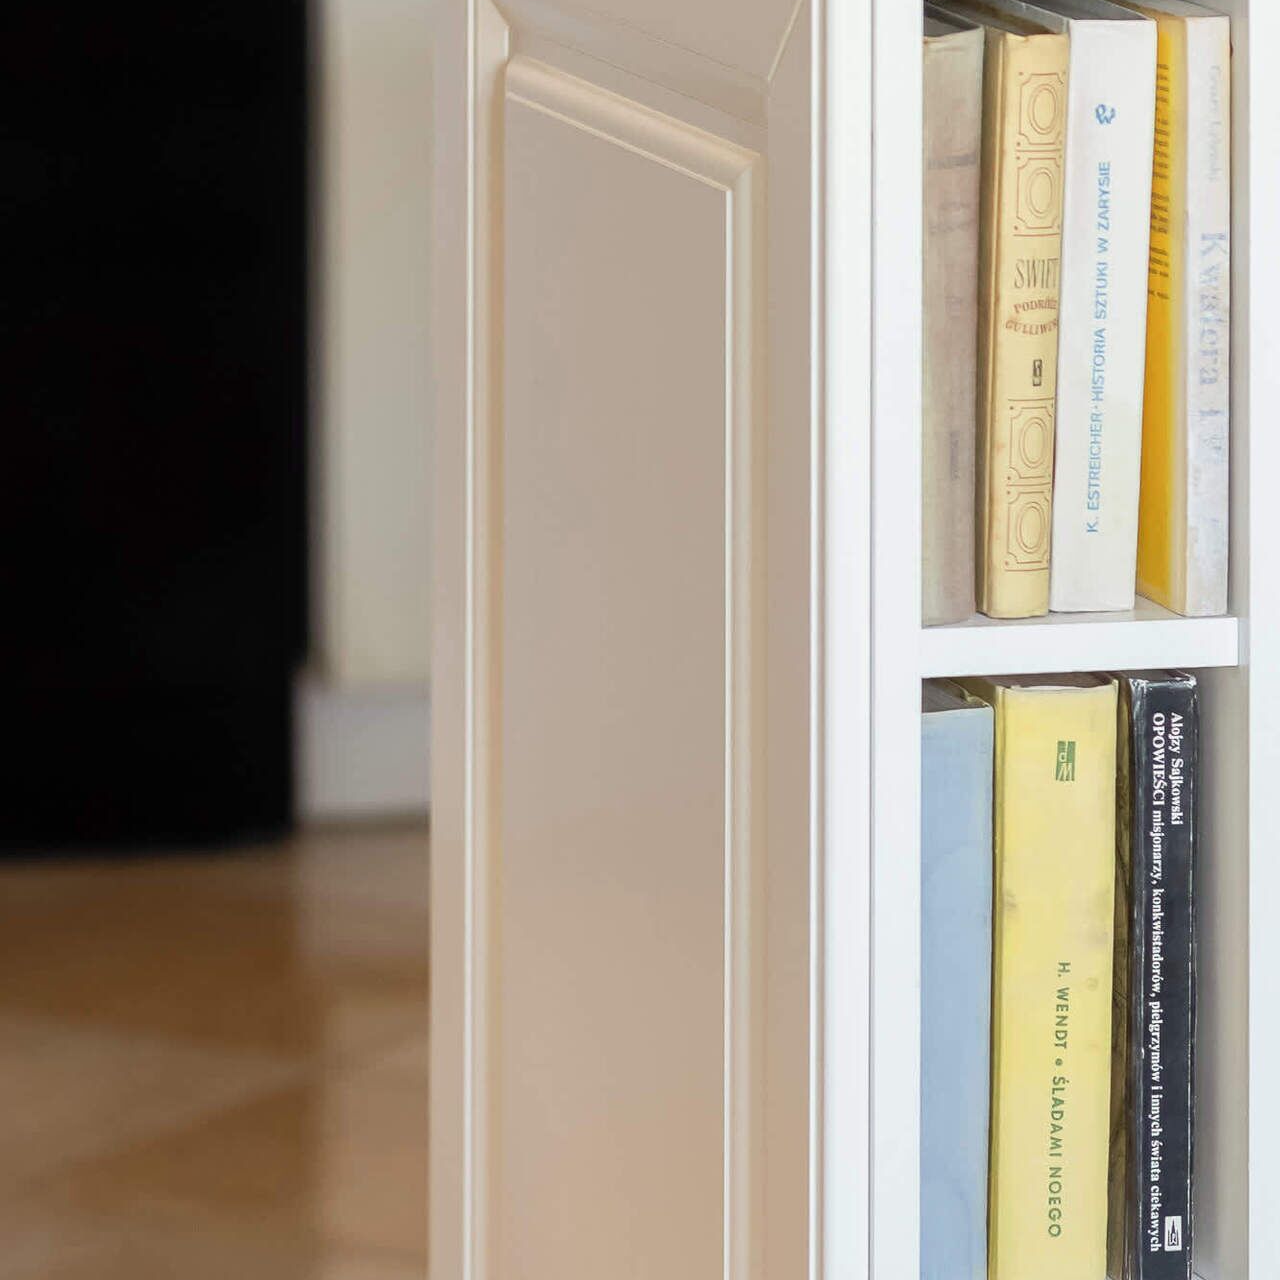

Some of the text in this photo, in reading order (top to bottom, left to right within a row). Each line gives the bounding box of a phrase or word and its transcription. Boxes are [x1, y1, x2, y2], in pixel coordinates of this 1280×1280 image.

[1014, 257, 1058, 289] SWIFT
[1086, 161, 1111, 534] K. ESTREICHER HISTORIA SZTUKI W ZARYSIE
[1151, 712, 1167, 806] OPOWIEŚCI
[1168, 712, 1184, 824] Alojzy Sajkowski
[1150, 810, 1165, 884] misjonarzy,
[1150, 889, 1164, 998] konkwistadorów,
[1150, 1002, 1164, 1082] pielgrzymów
[1047, 961, 1071, 1238] H. WENDT ŚLADAMI NOEGO
[1149, 1094, 1162, 1136] innych
[1150, 1140, 1164, 1181] świata
[1148, 1185, 1163, 1252] ciekawych
